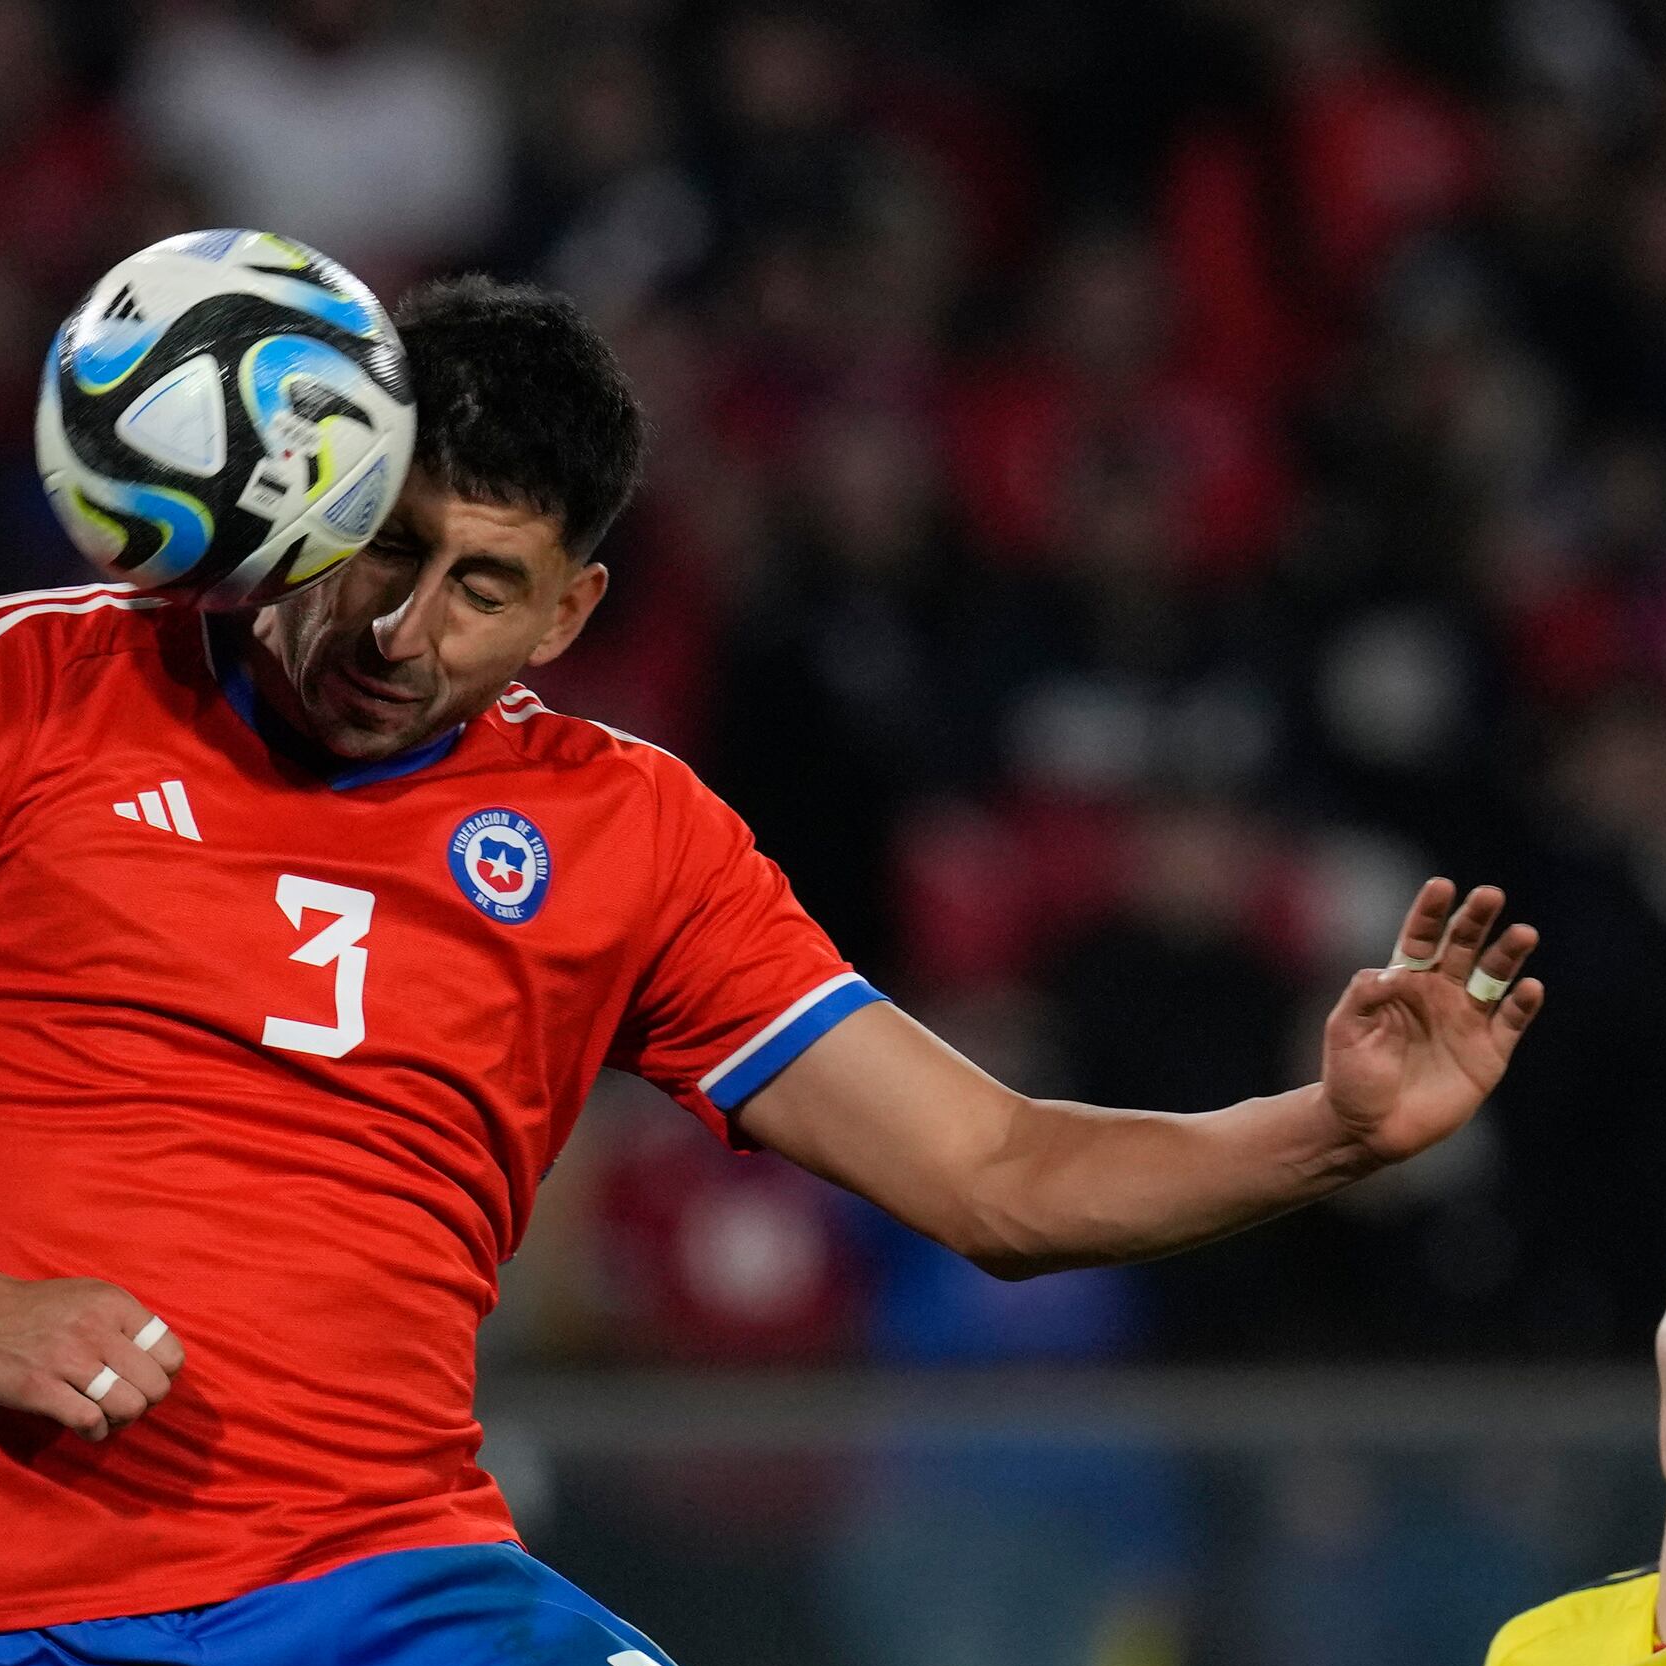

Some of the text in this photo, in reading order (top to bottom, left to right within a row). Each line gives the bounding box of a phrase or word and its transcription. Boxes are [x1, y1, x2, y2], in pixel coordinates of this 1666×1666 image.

[453, 812, 549, 880] FEDERACION DE FUTBOL
[475, 893, 523, 919] DE CHILE
[262, 874, 374, 1058] 3
